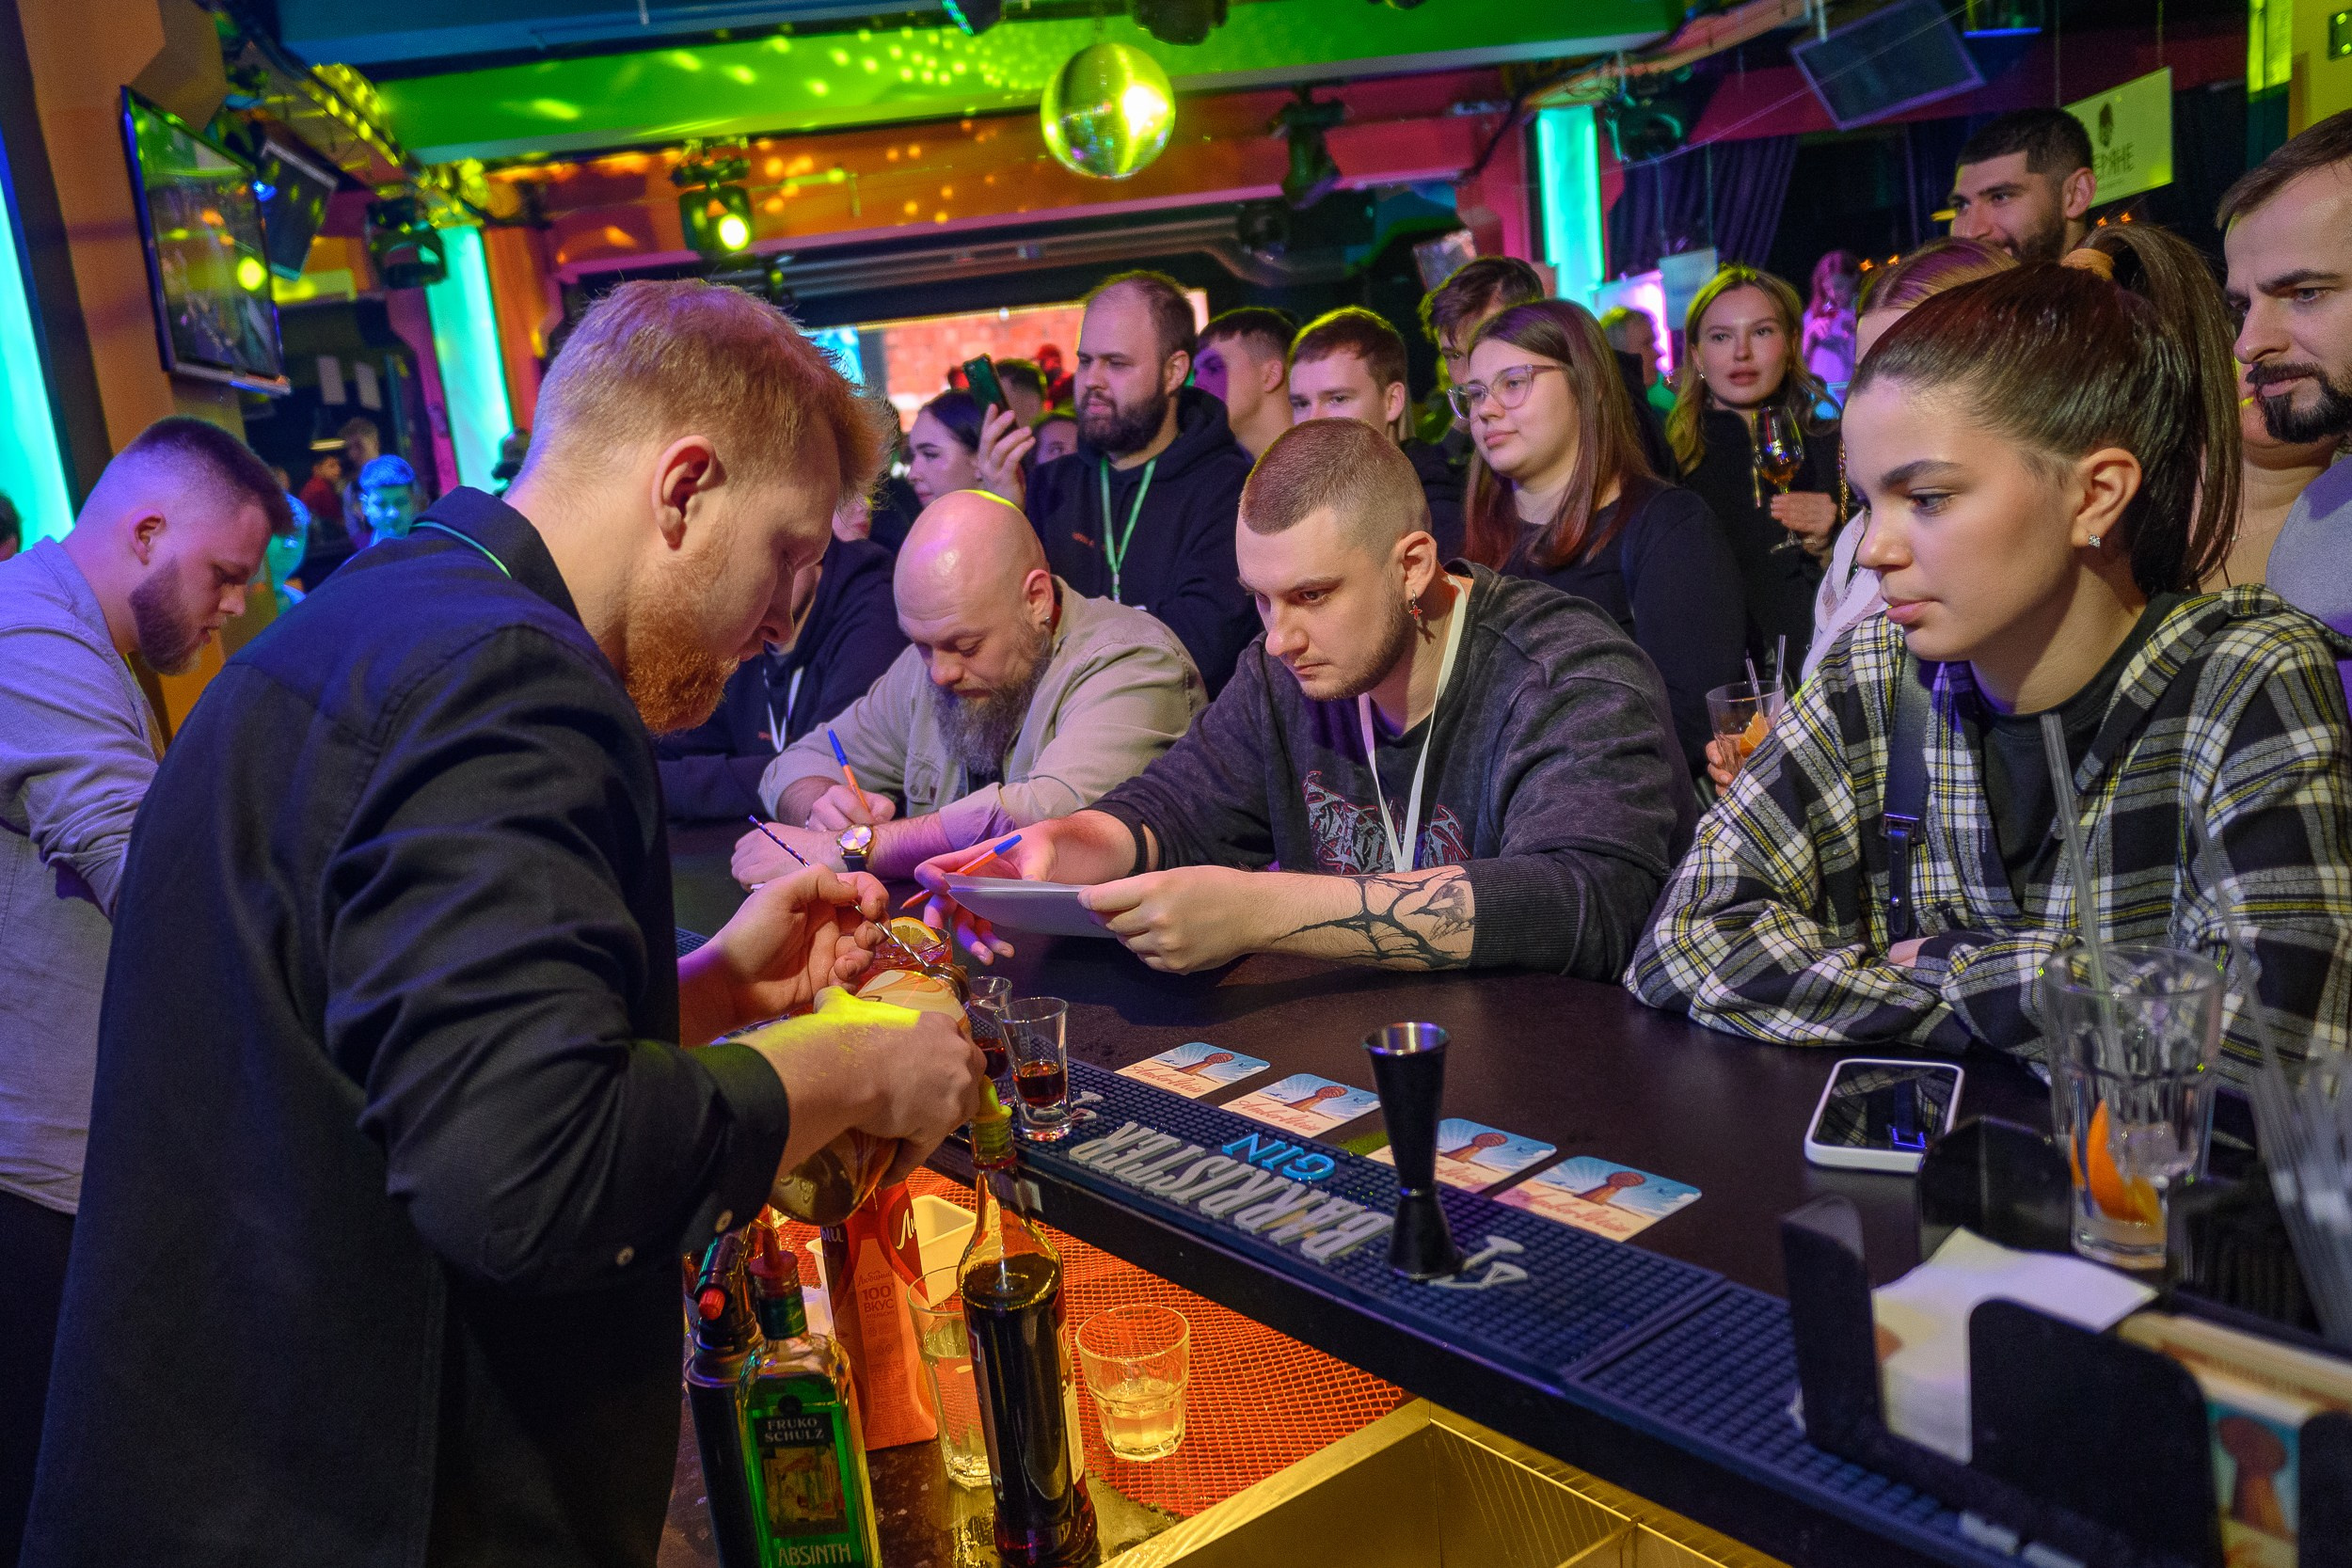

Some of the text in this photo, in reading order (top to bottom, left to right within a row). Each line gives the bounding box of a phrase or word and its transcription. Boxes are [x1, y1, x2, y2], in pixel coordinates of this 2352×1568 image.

[1222, 1132, 1336, 1180] GIN
[1069, 1121, 1396, 1265] BARRISTER
[864, 1298, 895, 1313] ВКУС
[767, 1417, 818, 1431] FRUKO
[764, 1428, 825, 1443] SCHULZ
[778, 1543, 852, 1567] ABSINTH
